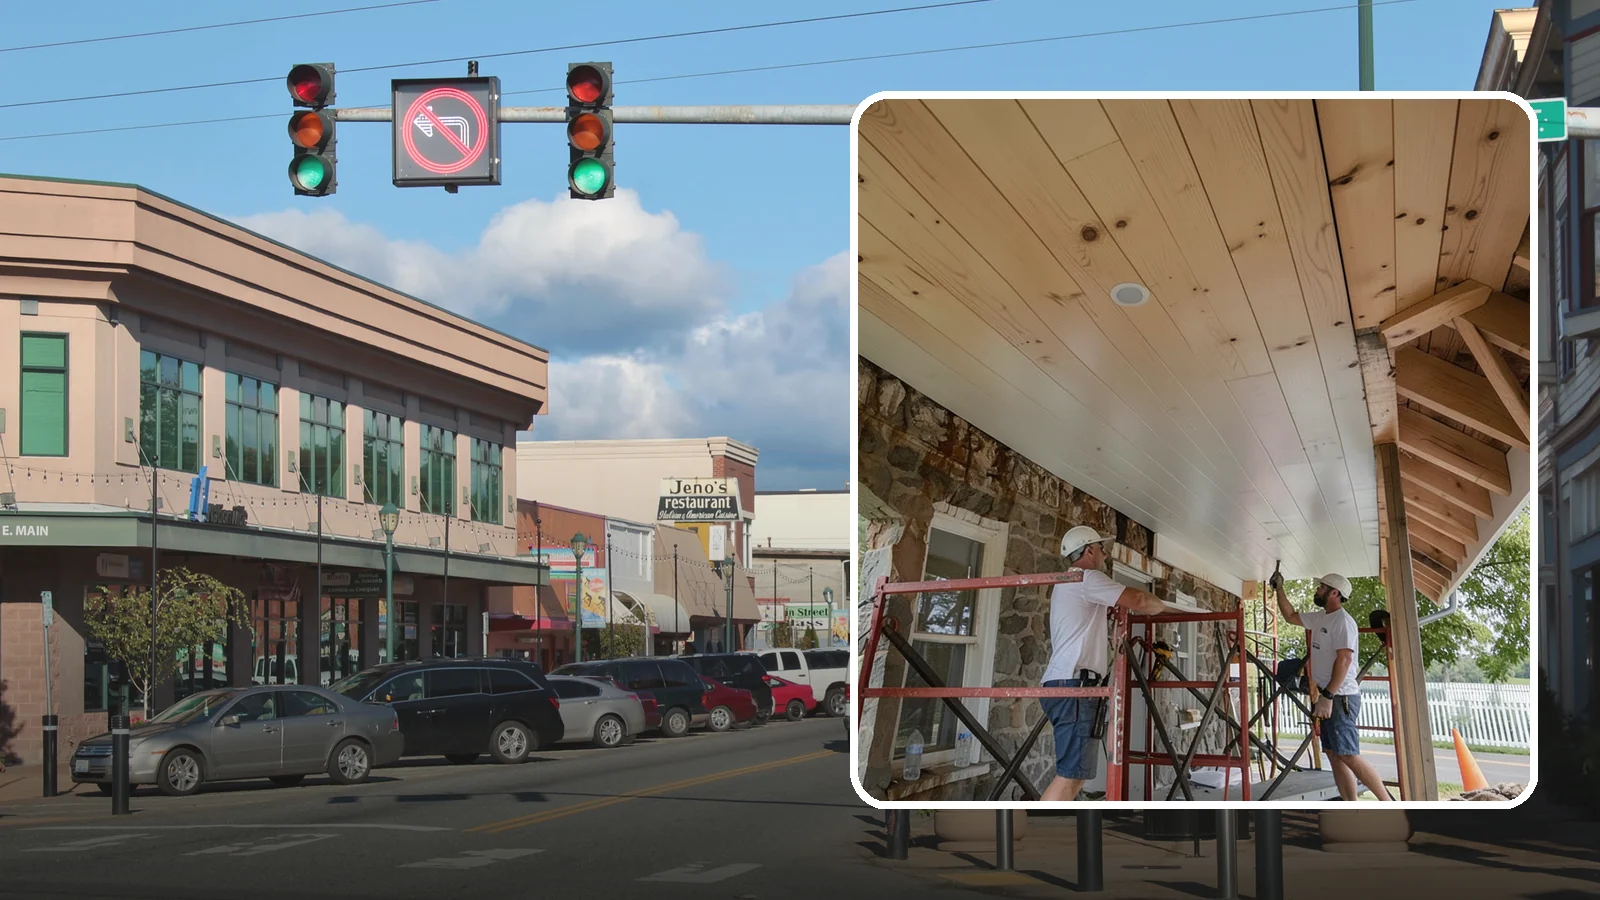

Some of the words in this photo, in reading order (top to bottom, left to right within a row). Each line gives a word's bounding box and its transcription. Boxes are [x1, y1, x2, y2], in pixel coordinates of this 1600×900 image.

[669, 479, 728, 495] Jeno's
[664, 496, 731, 509] restaurant
[686, 509, 714, 520] American
[715, 509, 737, 520] Cuisine
[2, 525, 13, 536] E.
[15, 525, 49, 536] MAIN
[797, 607, 828, 617] Street
